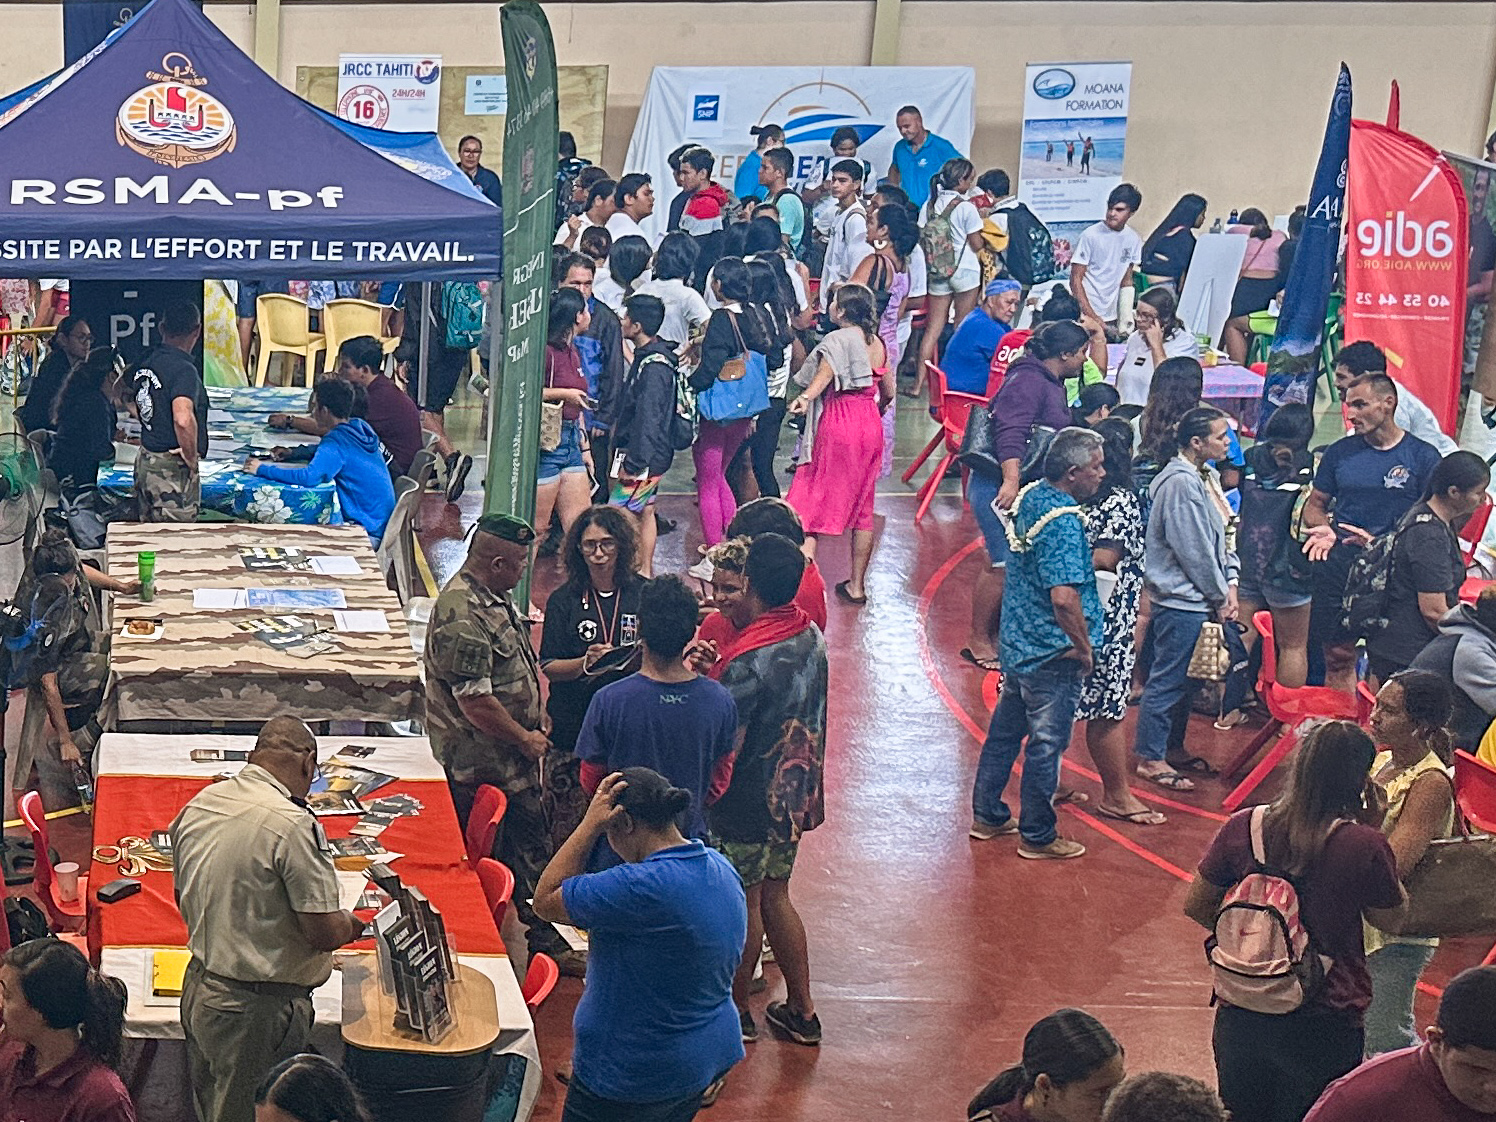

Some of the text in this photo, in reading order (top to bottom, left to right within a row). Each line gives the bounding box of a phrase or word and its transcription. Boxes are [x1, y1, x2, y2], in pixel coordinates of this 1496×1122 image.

[342, 63, 414, 76] JRCC TAHITI
[1084, 83, 1124, 94] MOANA
[353, 100, 374, 119] 16
[1065, 99, 1123, 111] FORMATION
[11, 175, 343, 210] RSMA-pf
[69, 239, 122, 259] PAR
[131, 238, 261, 260] L'EFFORT
[269, 240, 303, 260] ET
[311, 241, 344, 261] LE
[352, 241, 475, 262] TRAVAIL.
[110, 312, 156, 348] Pf
